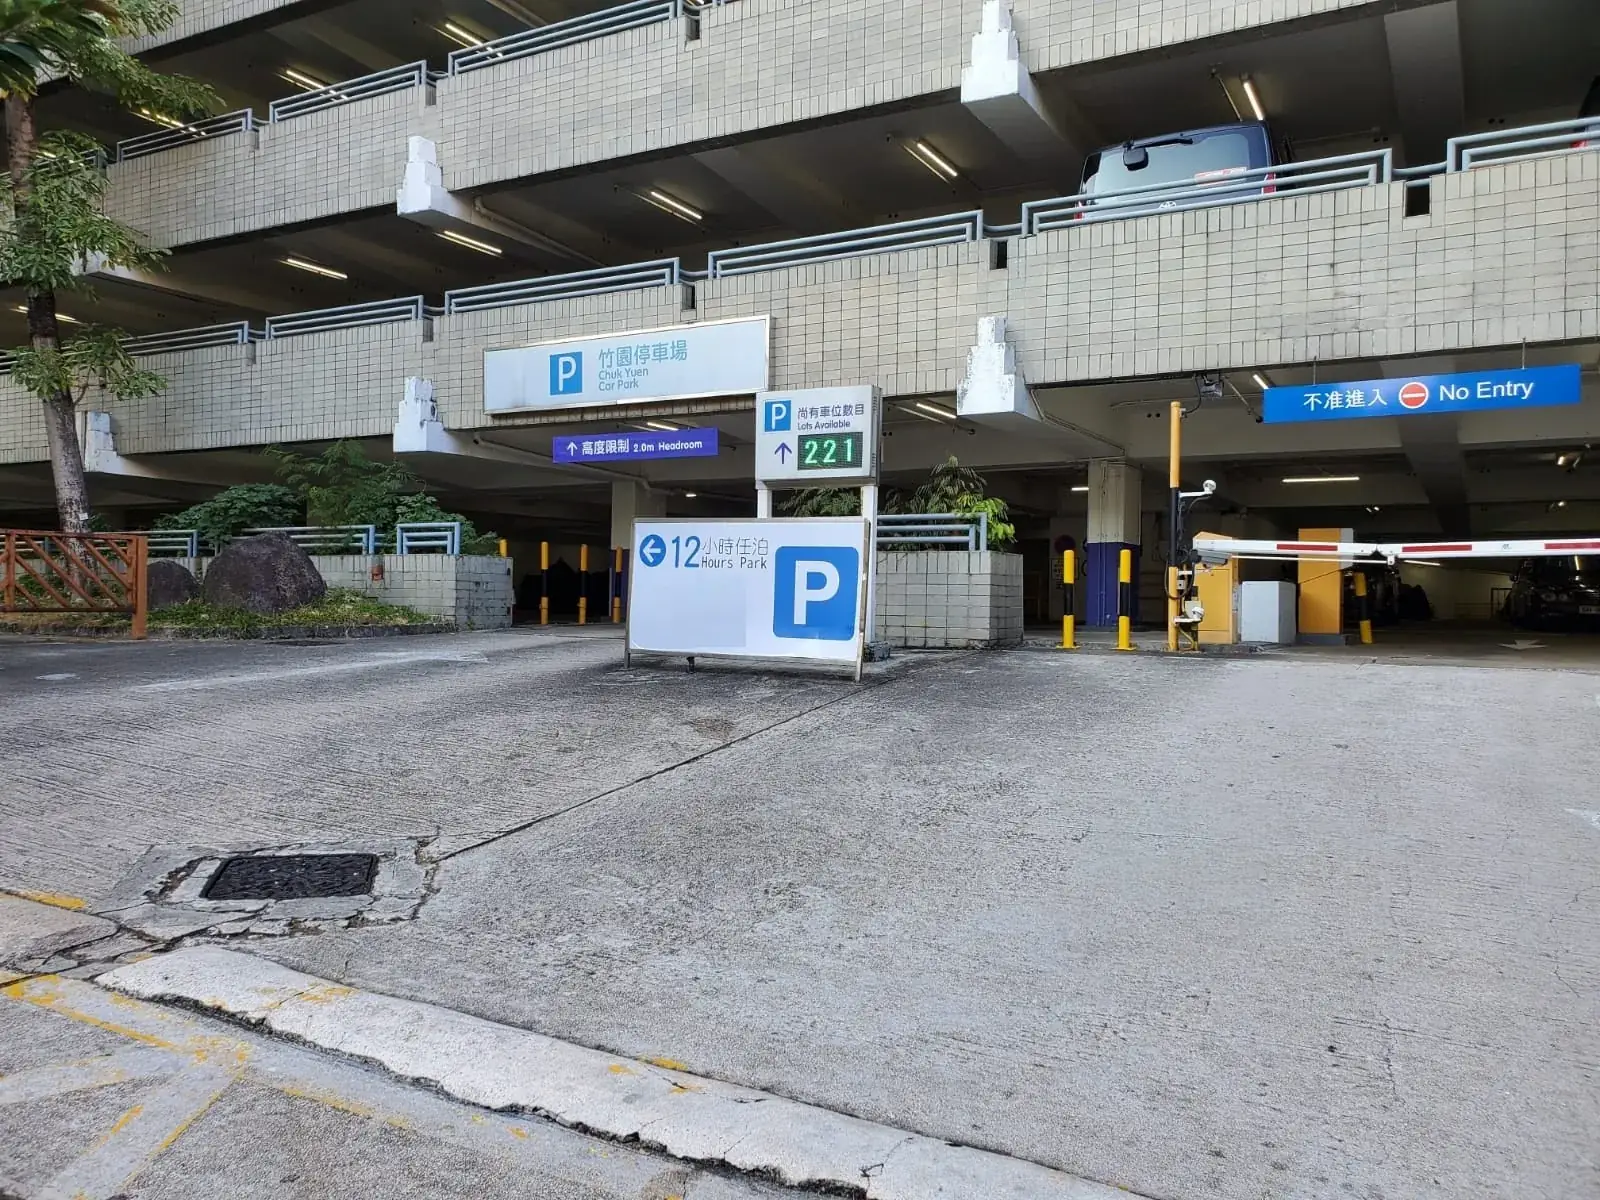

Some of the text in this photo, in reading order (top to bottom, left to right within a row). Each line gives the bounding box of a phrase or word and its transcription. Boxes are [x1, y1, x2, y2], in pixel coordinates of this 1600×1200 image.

[598, 339, 687, 369] 竹園停車場
[558, 356, 577, 392] P
[598, 367, 649, 380] Chuk Yuen
[598, 378, 640, 391] Car Park
[1302, 381, 1534, 412] 不准進入 No Entry
[771, 403, 787, 430] P
[797, 403, 865, 419] 尚有車位數目
[797, 419, 851, 430] Lots Available
[581, 438, 703, 456] 高度限制 2.0m Headroom
[804, 438, 853, 464] 221
[701, 556, 767, 569] Hours Park
[793, 560, 840, 625] P
